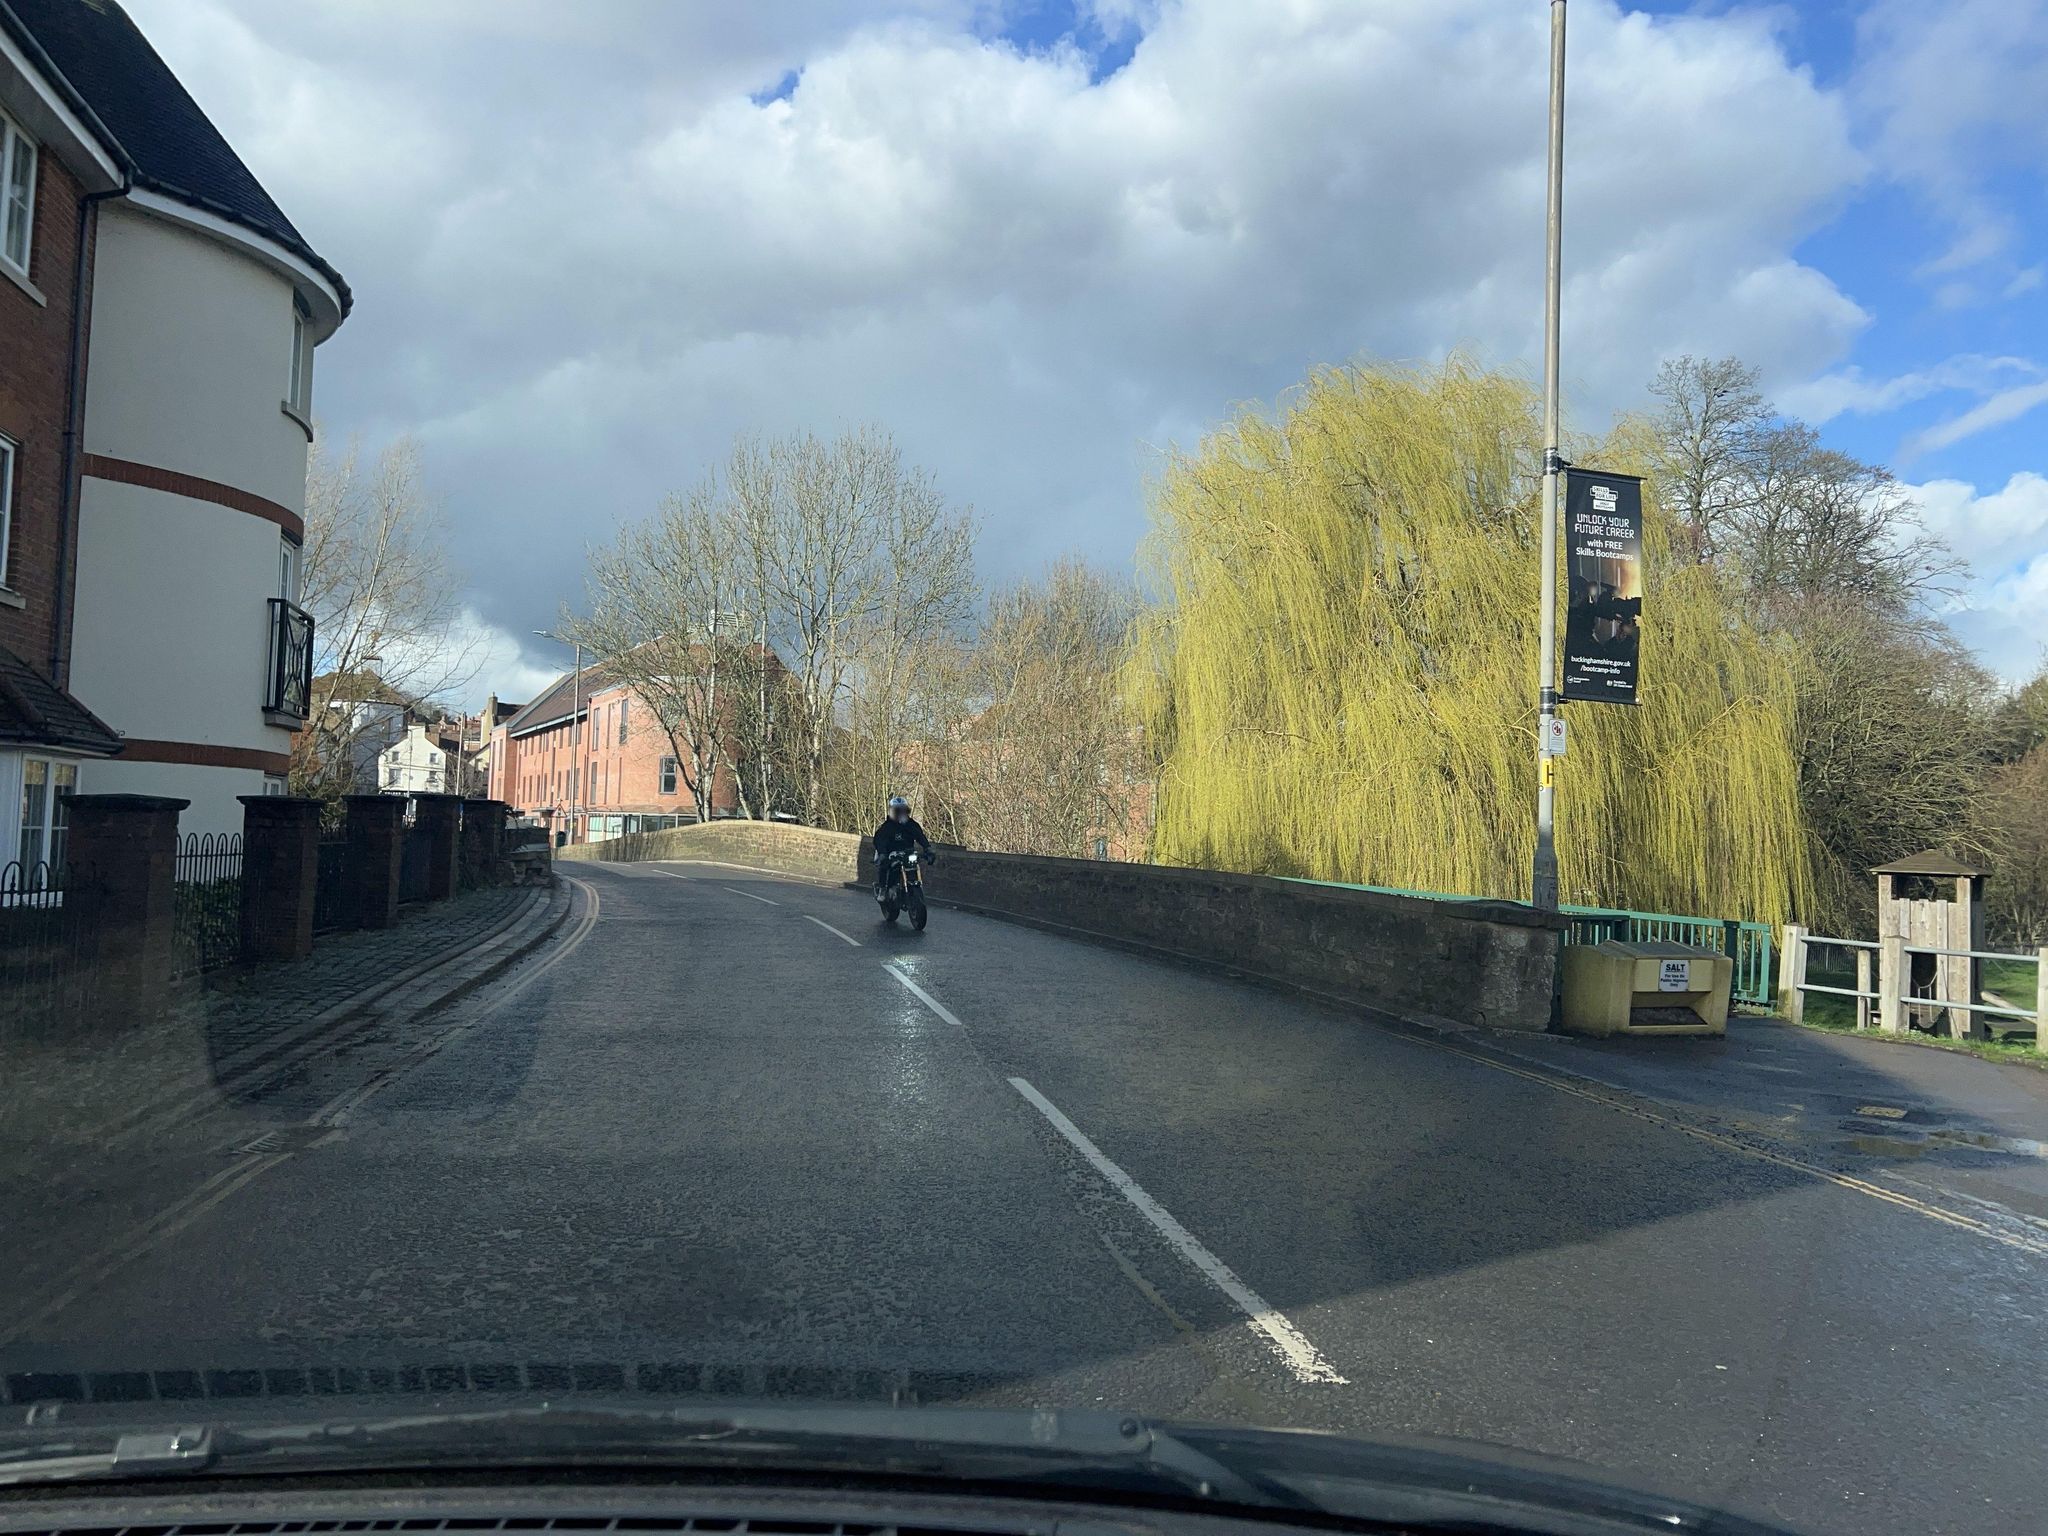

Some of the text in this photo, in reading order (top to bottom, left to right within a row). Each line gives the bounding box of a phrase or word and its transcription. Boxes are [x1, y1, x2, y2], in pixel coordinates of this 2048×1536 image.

[1577, 514, 1630, 528] UNLOCK YOUR
[1574, 524, 1634, 539] FUTURE CAREER
[1587, 539, 1622, 550] with FREE
[1576, 547, 1634, 560] Skills Bootcamps
[1570, 656, 1631, 667] buckinghamshire.gov.uk
[1580, 665, 1620, 674] /bootcamp-info
